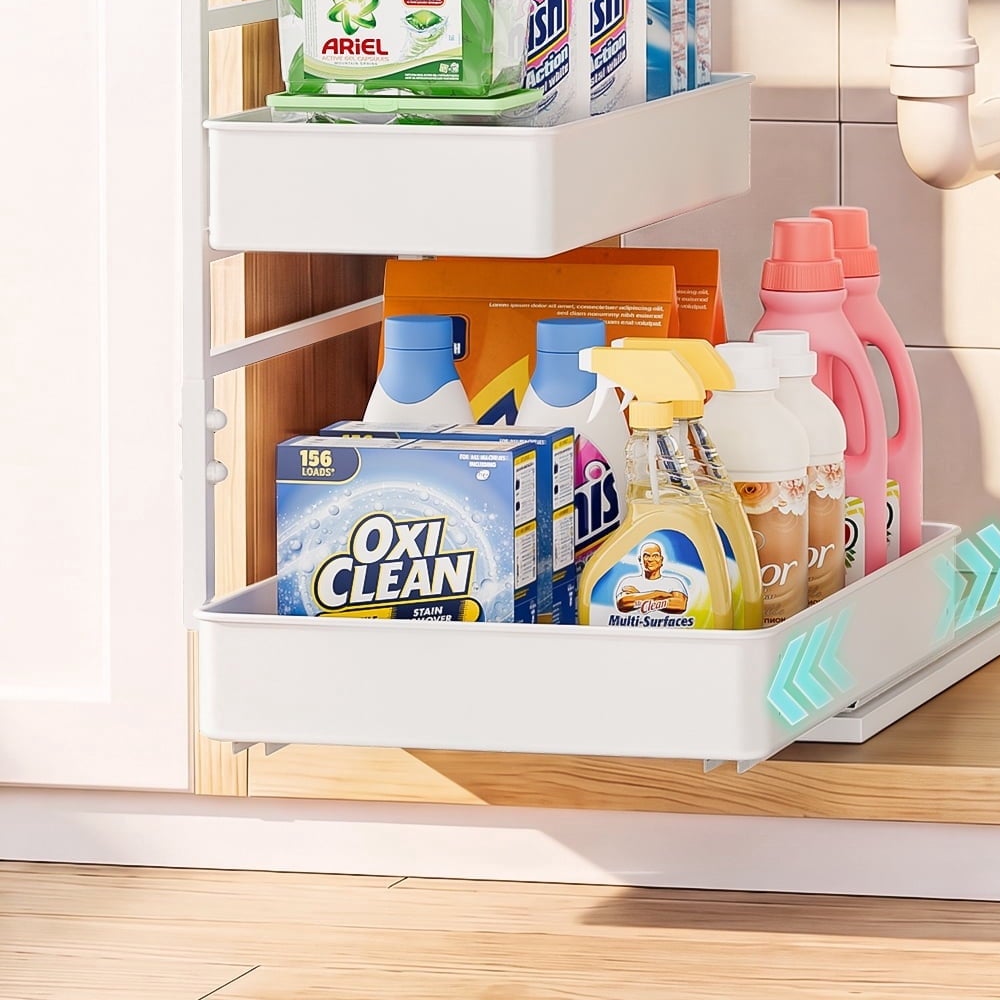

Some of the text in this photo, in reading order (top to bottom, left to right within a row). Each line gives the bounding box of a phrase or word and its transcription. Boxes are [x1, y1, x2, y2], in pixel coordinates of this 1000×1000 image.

[526, 45, 569, 89] Action
[299, 449, 332, 467] 156
[352, 515, 443, 564] OXI
[316, 553, 471, 608] CLEAN
[413, 606, 443, 617] STAIN
[641, 600, 667, 613] Clean
[609, 615, 694, 627] Multi-Surfaces
